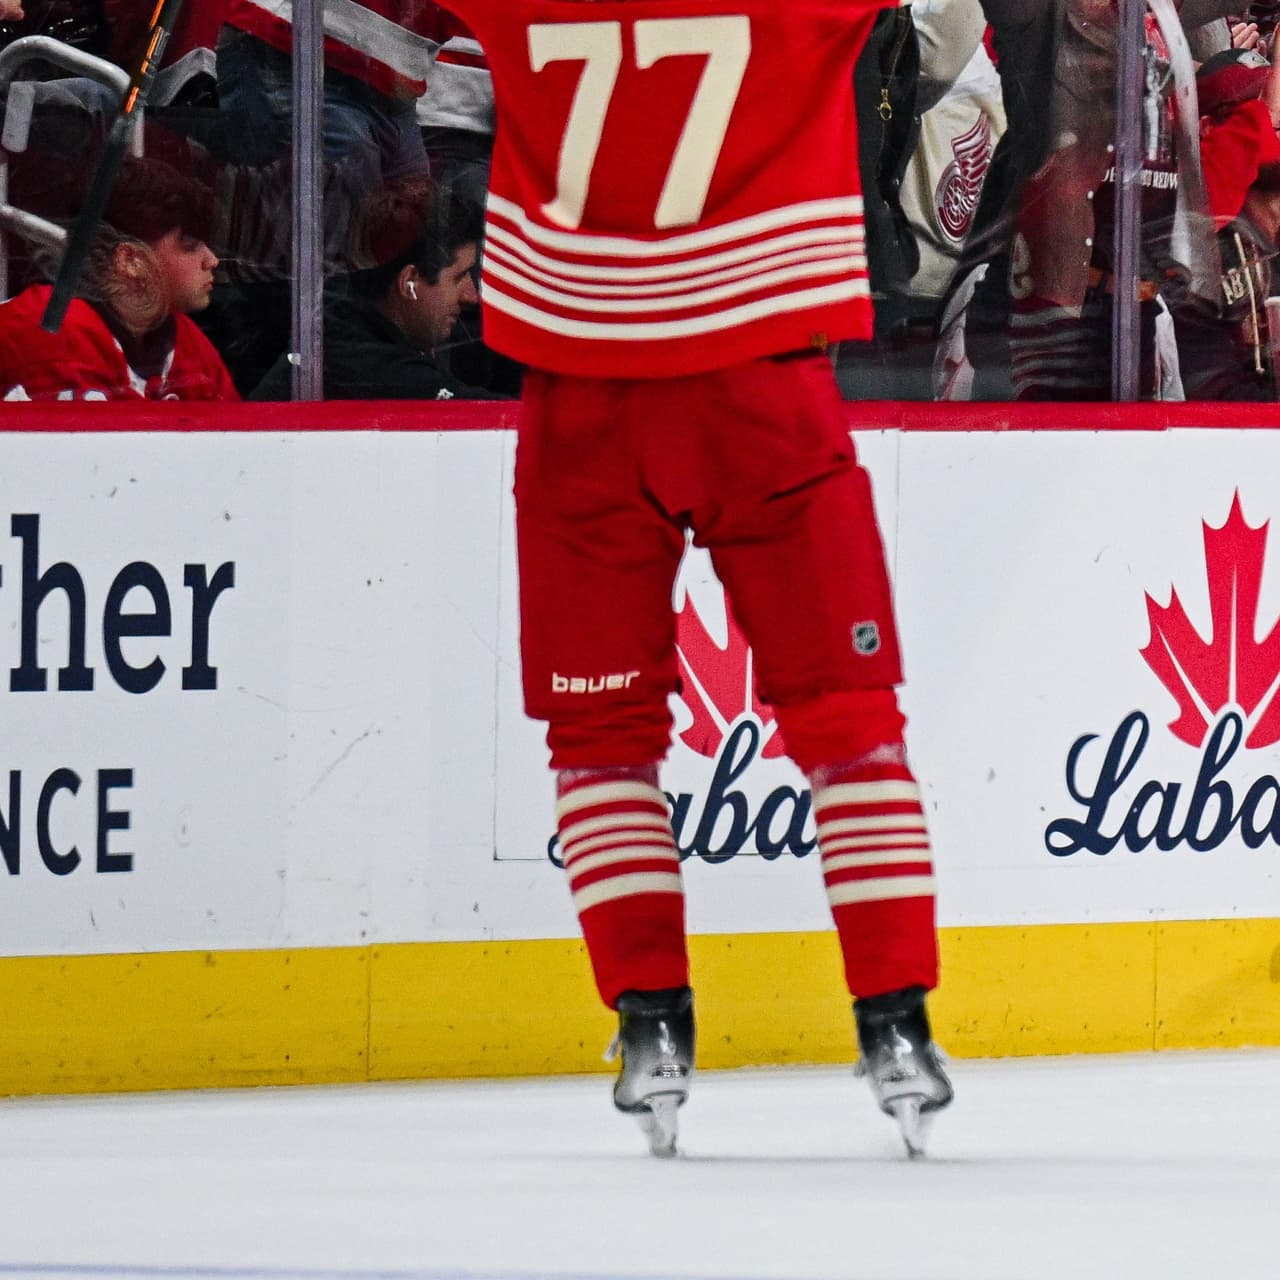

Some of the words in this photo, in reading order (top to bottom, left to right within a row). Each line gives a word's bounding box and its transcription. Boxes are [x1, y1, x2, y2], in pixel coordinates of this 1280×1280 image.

[527, 14, 752, 231] 77
[0, 513, 236, 695] her
[551, 669, 641, 694] bauer
